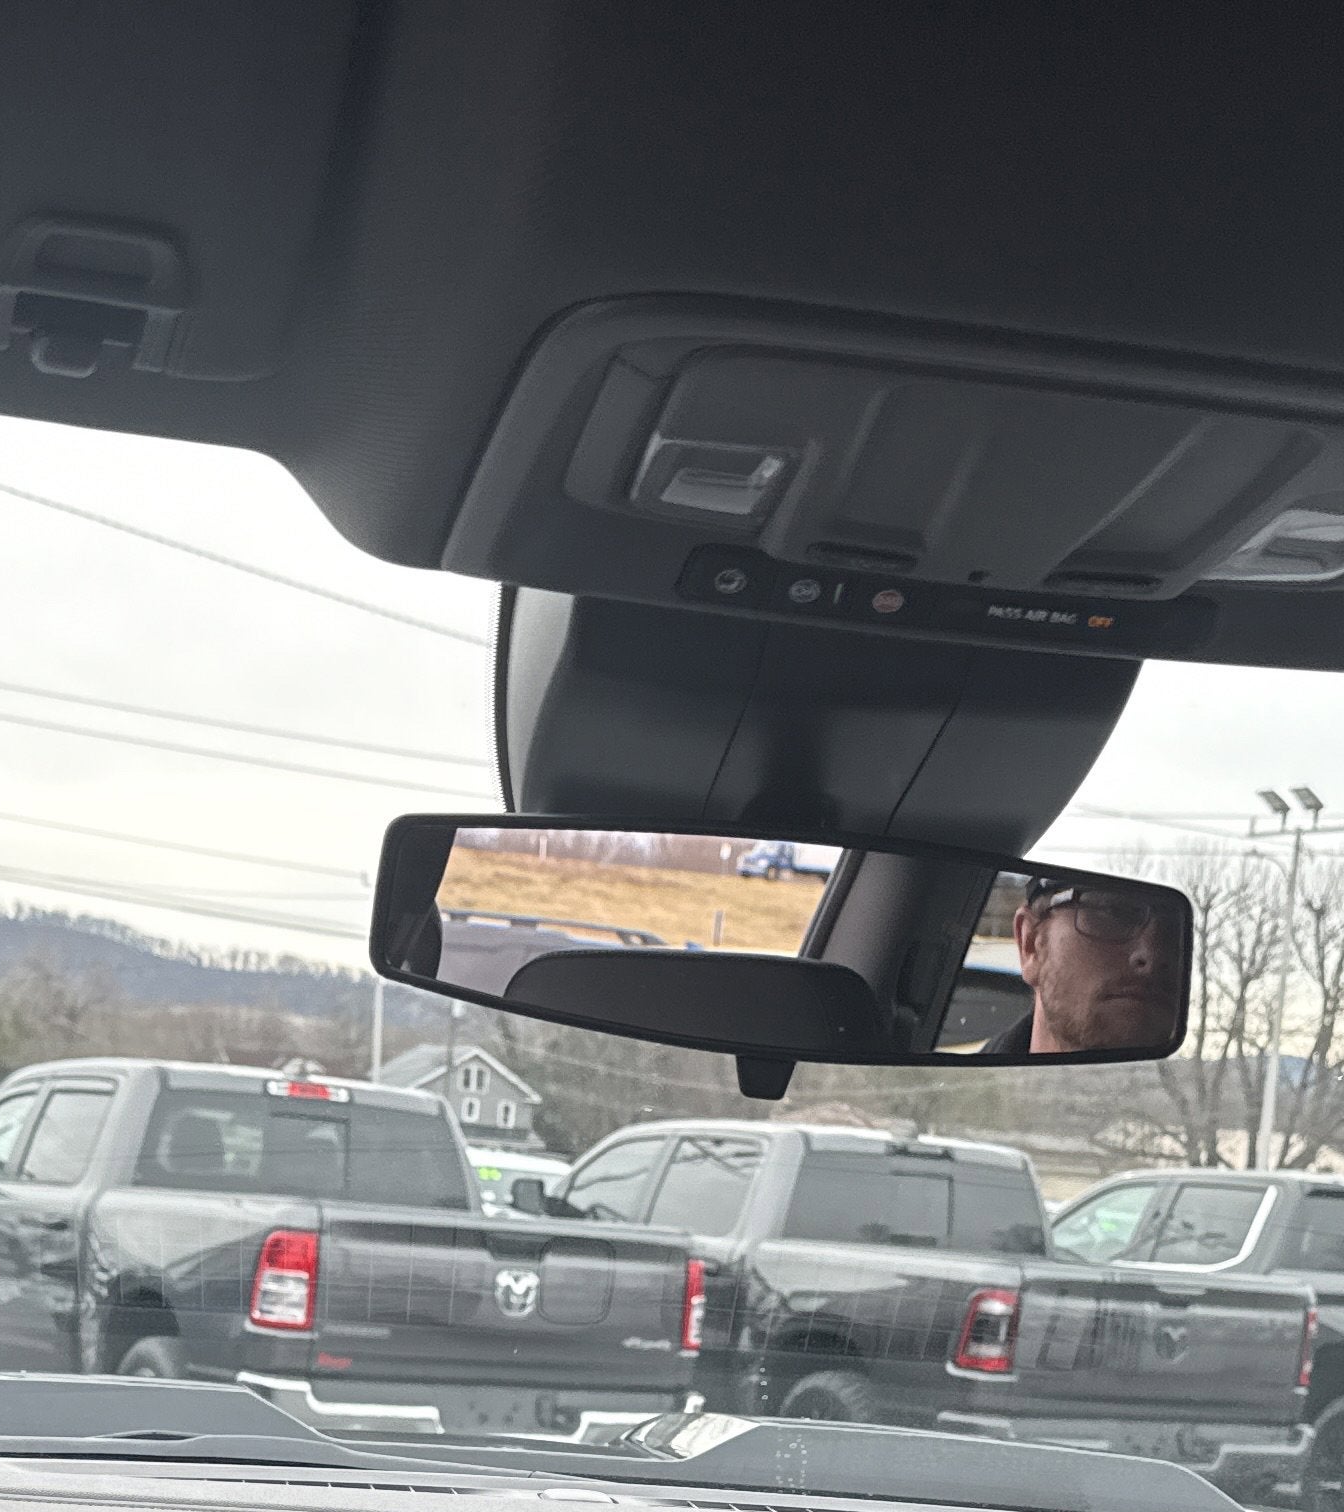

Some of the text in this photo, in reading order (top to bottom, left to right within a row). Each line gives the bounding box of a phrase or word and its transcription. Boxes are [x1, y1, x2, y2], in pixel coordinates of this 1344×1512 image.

[987, 604, 1023, 619] PASS
[1025, 610, 1048, 622] AIR
[1087, 615, 1115, 628] OFF
